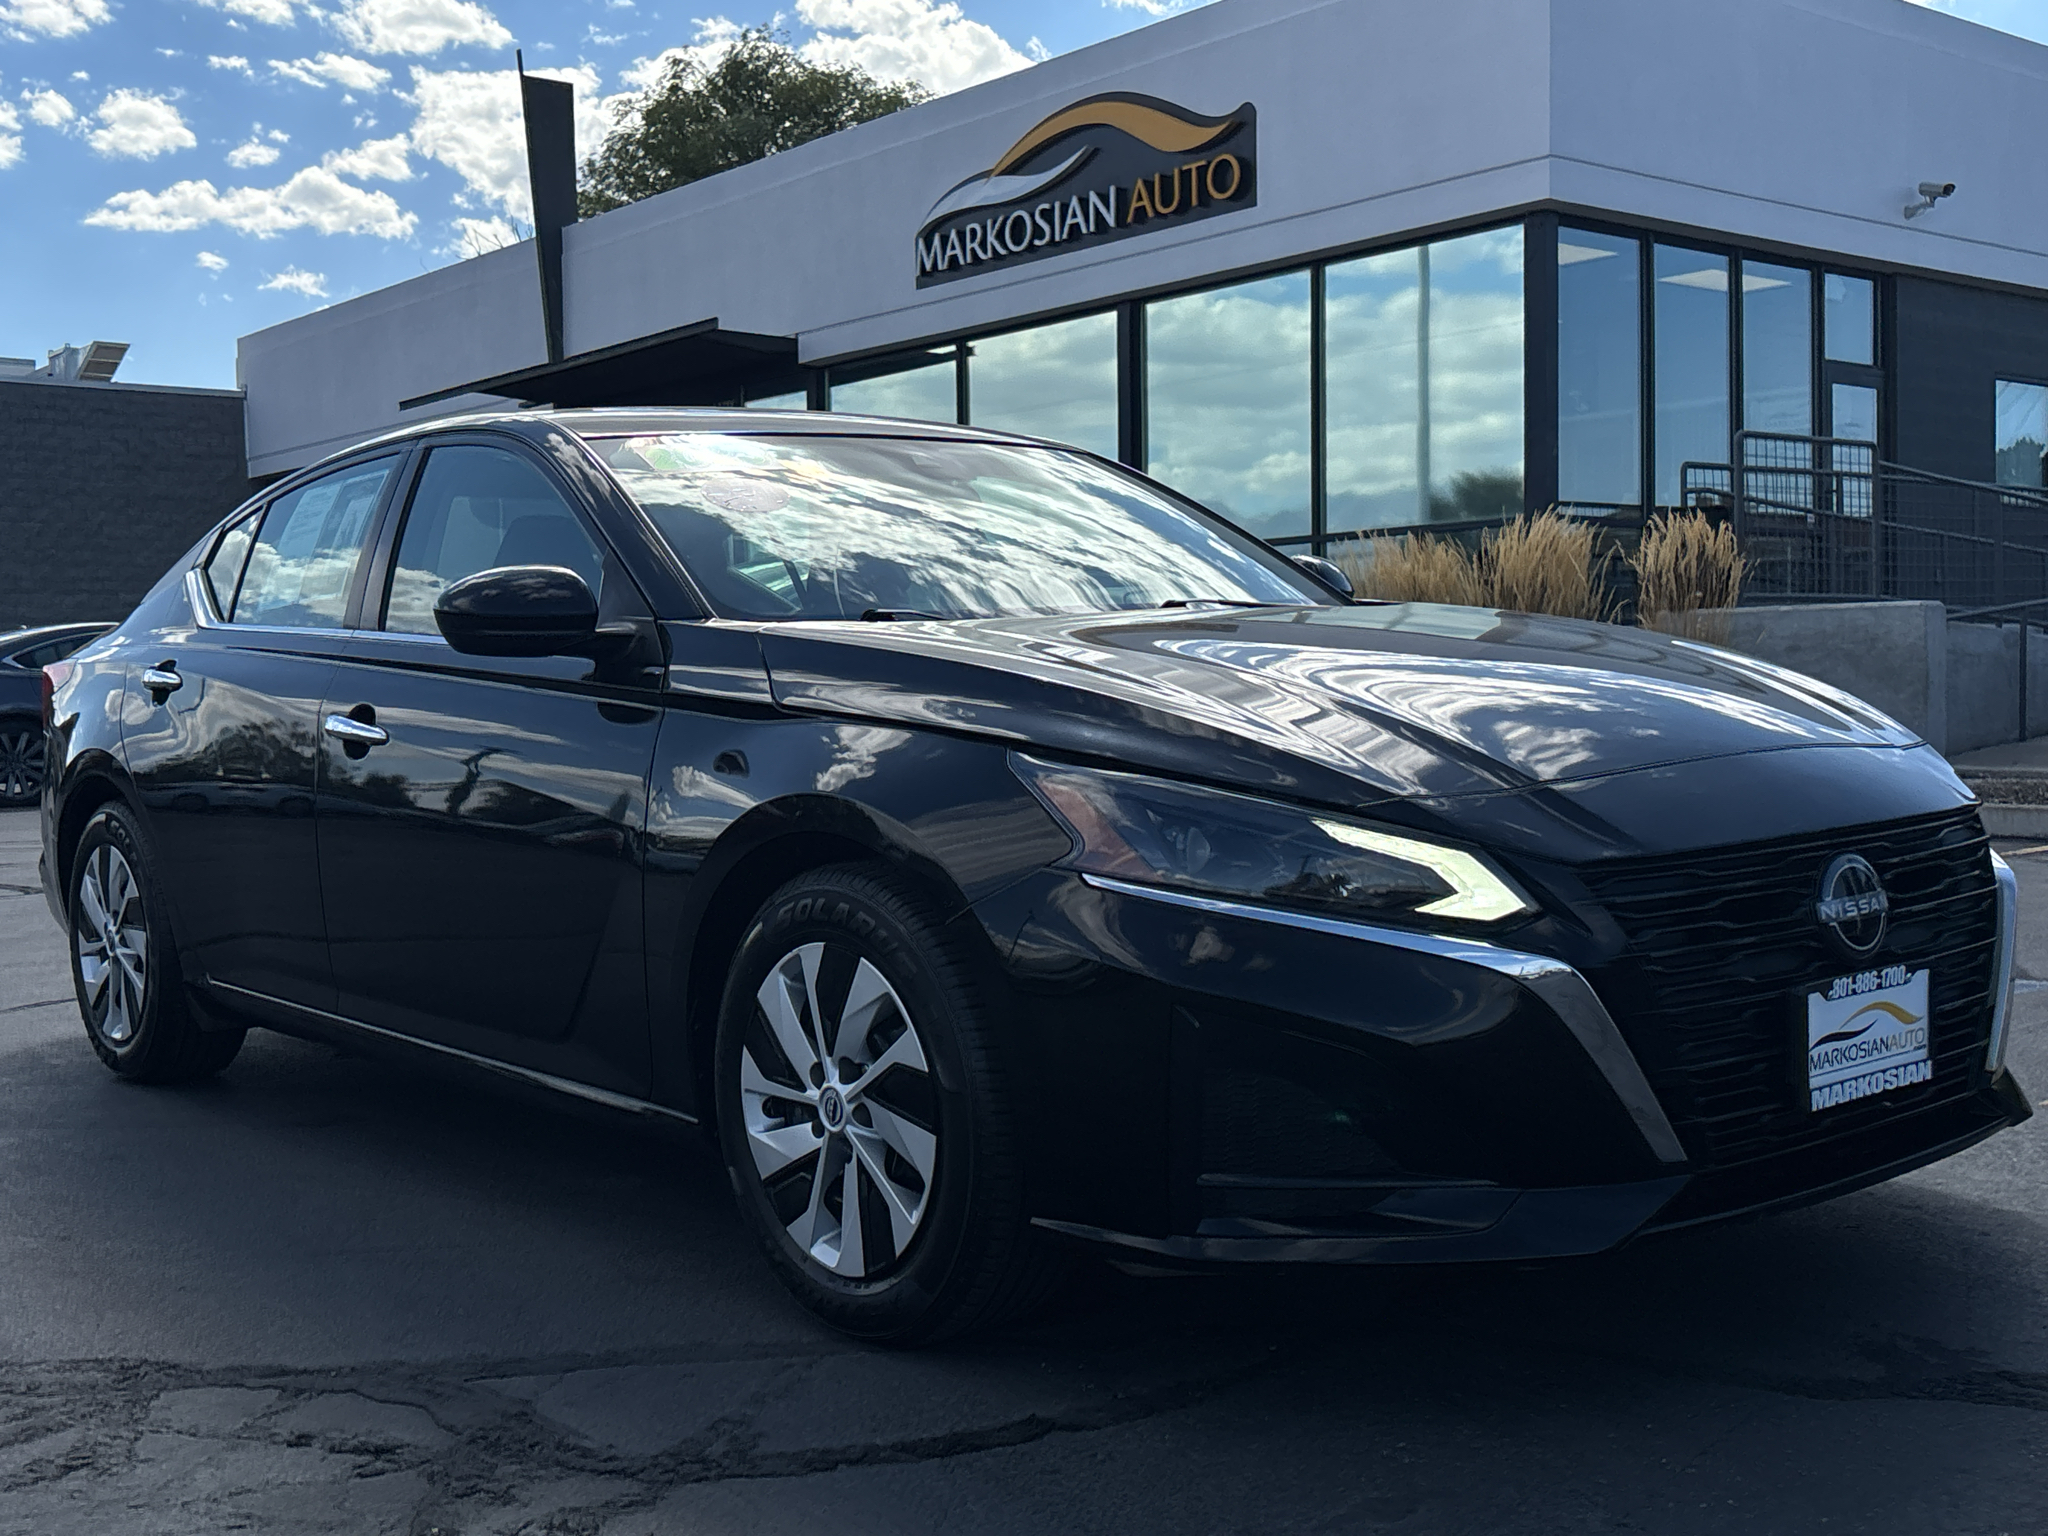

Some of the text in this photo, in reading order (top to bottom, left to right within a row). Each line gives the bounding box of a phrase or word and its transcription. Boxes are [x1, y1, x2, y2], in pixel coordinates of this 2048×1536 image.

[917, 153, 1241, 276] MARKOSIAN AUTO
[1820, 892, 1887, 920] NISSA
[1832, 964, 1906, 999] 801-886-1700
[1811, 1059, 1932, 1112] MARKOSIAN
